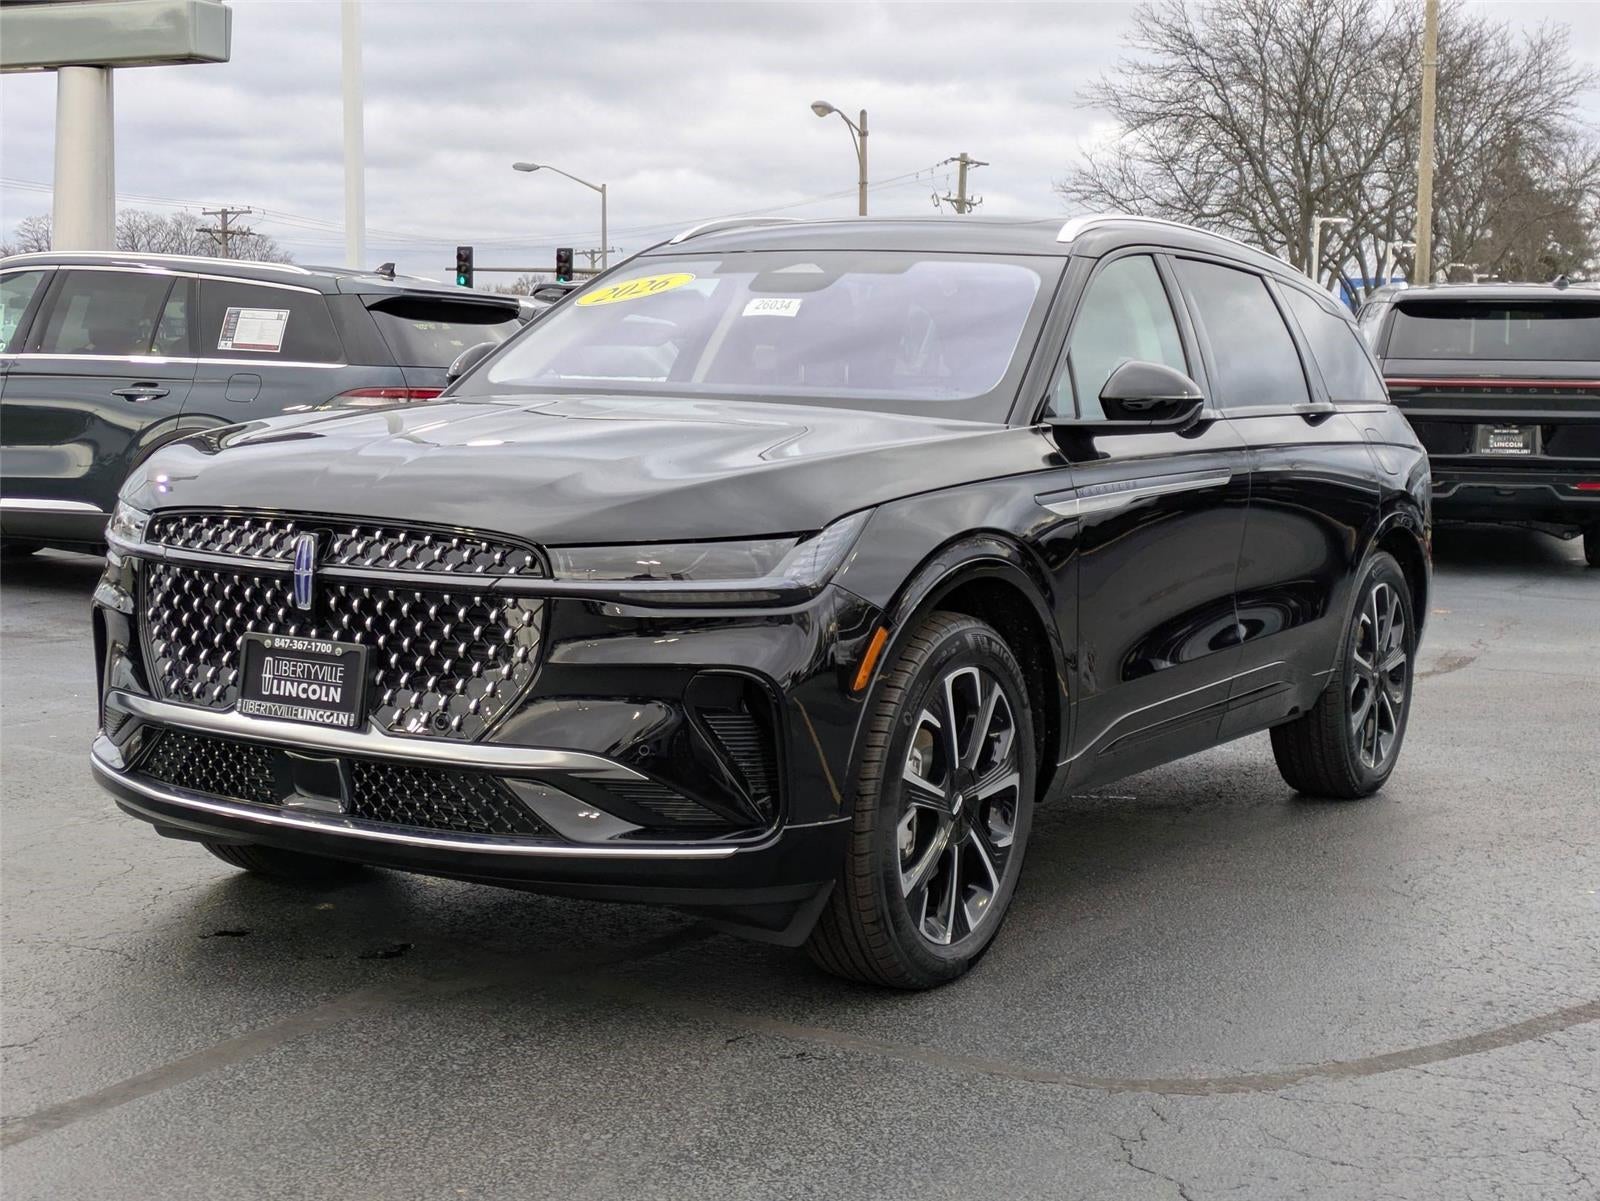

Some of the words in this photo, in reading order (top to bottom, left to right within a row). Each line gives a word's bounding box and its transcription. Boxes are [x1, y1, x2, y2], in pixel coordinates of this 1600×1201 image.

[592, 279, 670, 303] 2026
[755, 299, 792, 310] 26034
[274, 637, 332, 653] 847-367-1700
[274, 660, 344, 684] LIBERTYVILLE
[272, 680, 341, 703] LINCOLN
